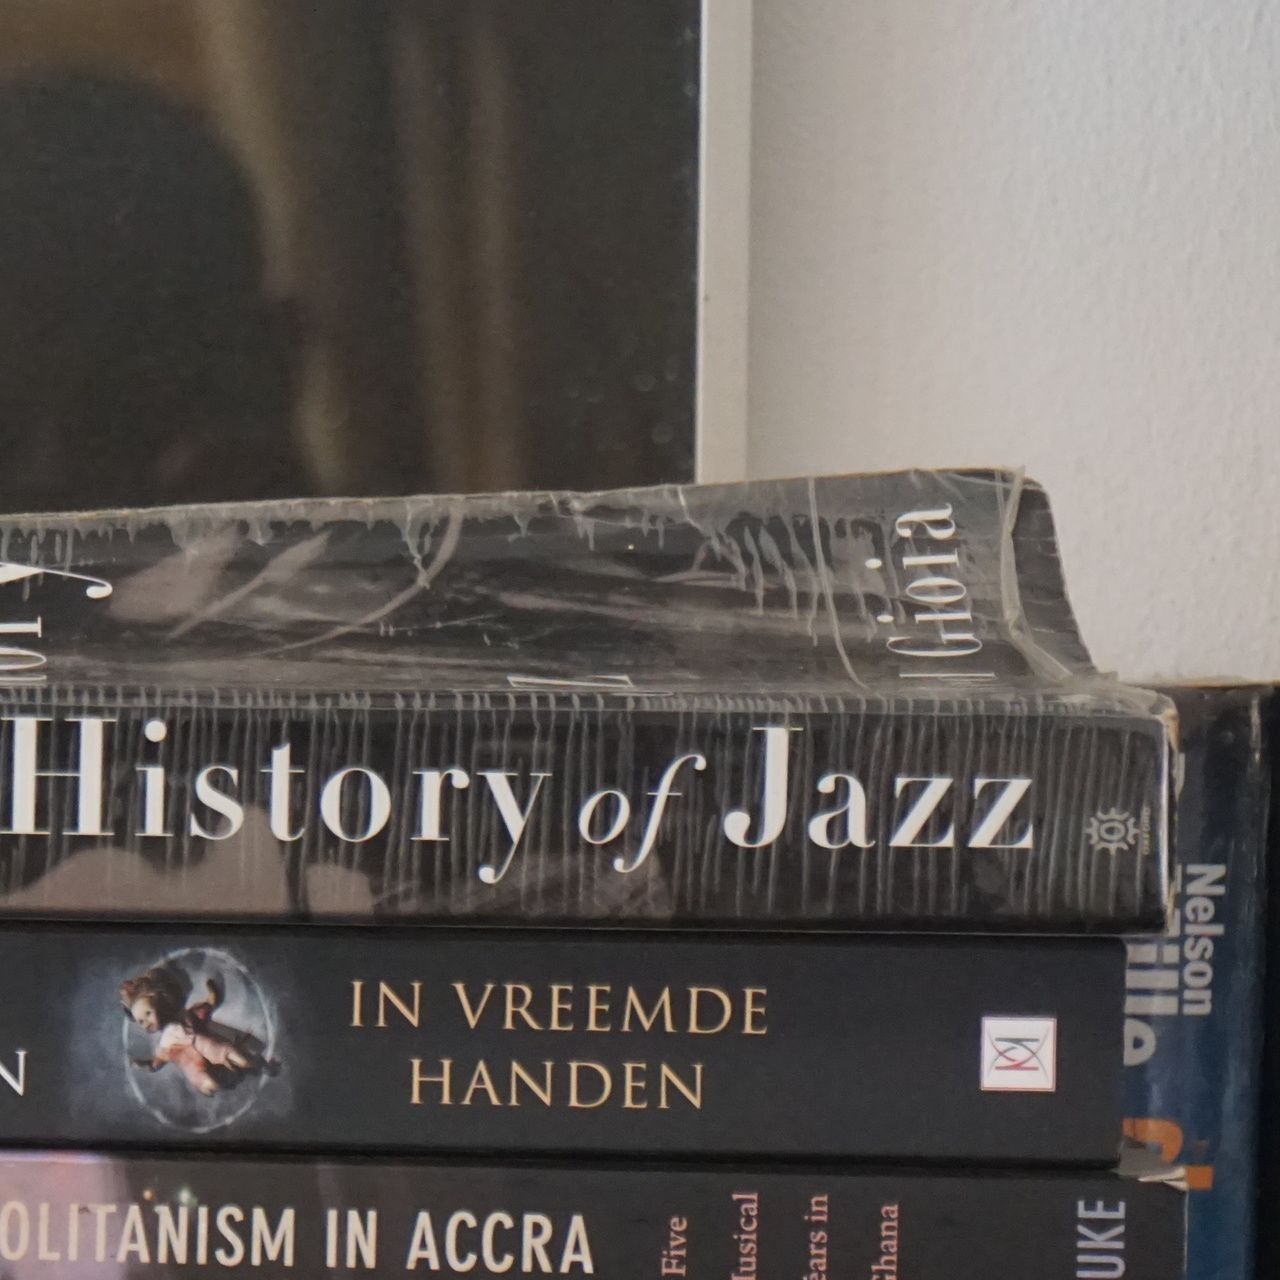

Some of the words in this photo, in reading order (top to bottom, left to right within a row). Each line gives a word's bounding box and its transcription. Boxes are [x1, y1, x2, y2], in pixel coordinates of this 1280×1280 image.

[865, 503, 983, 657] Gioia
[0, 717, 551, 882] History
[577, 753, 708, 874] of
[722, 727, 1033, 849] Jazz
[1183, 863, 1226, 1016] Nelson
[350, 979, 421, 1030] IN
[452, 981, 769, 1036] VREEMDE
[410, 1058, 705, 1111] HANDEN
[324, 1209, 378, 1270] IN
[405, 1210, 595, 1275] ACCRA
[803, 1194, 828, 1233] in
[660, 1216, 688, 1278] Five
